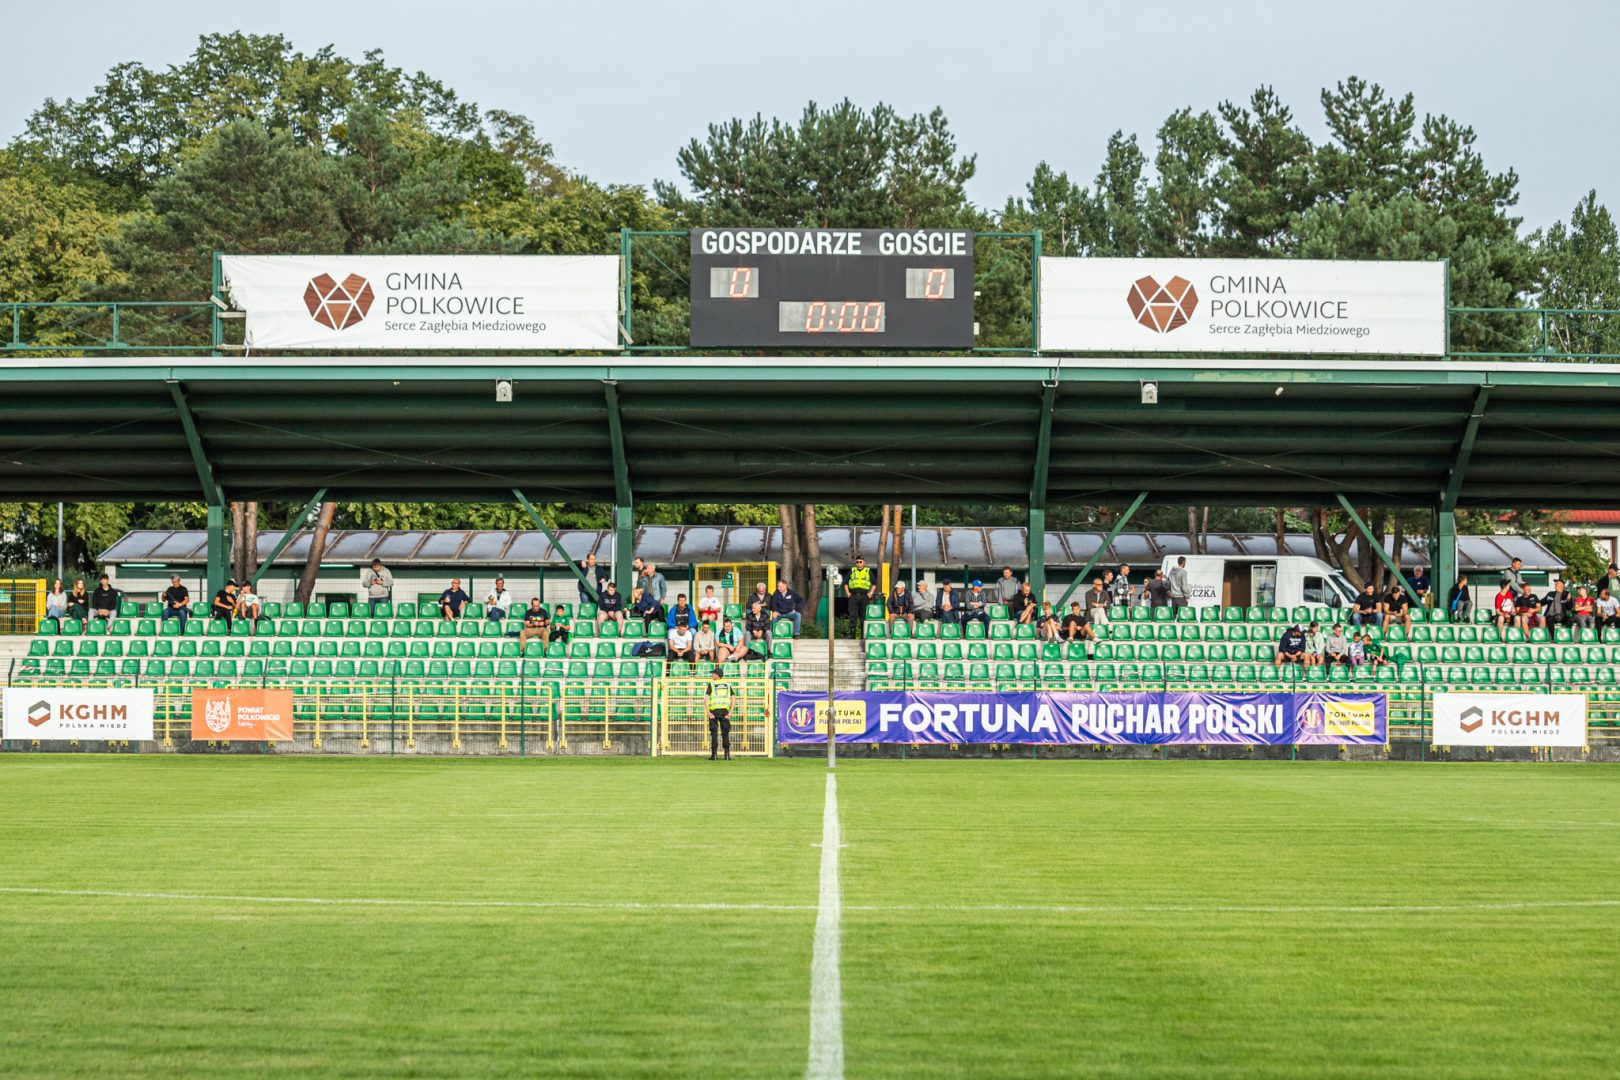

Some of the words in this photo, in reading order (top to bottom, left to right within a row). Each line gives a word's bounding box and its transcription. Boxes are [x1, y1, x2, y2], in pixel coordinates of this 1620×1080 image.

[701, 231, 862, 255] GOSPODARZE
[878, 230, 966, 255] GOŚCIE
[386, 272, 462, 290] GMINA
[729, 267, 752, 298] 0
[925, 268, 947, 299] 0
[1210, 275, 1287, 294] GMINA
[386, 296, 525, 315] POLKOWICE
[1211, 300, 1348, 319] POLKOWICE
[385, 321, 415, 331] Serce
[419, 320, 468, 333] Zagłębia
[472, 320, 547, 333] Miedziowego
[804, 302, 883, 332] 0:00
[1209, 324, 1241, 334] Serce
[1244, 323, 1293, 337] Zagłębia
[1296, 324, 1370, 338] Miedziowego
[59, 704, 127, 720] KGHM
[879, 703, 1058, 733] FORTUNA
[1072, 703, 1182, 734] PUCHAR
[1188, 704, 1283, 734] POLSKI
[1491, 710, 1560, 726] KGHM
